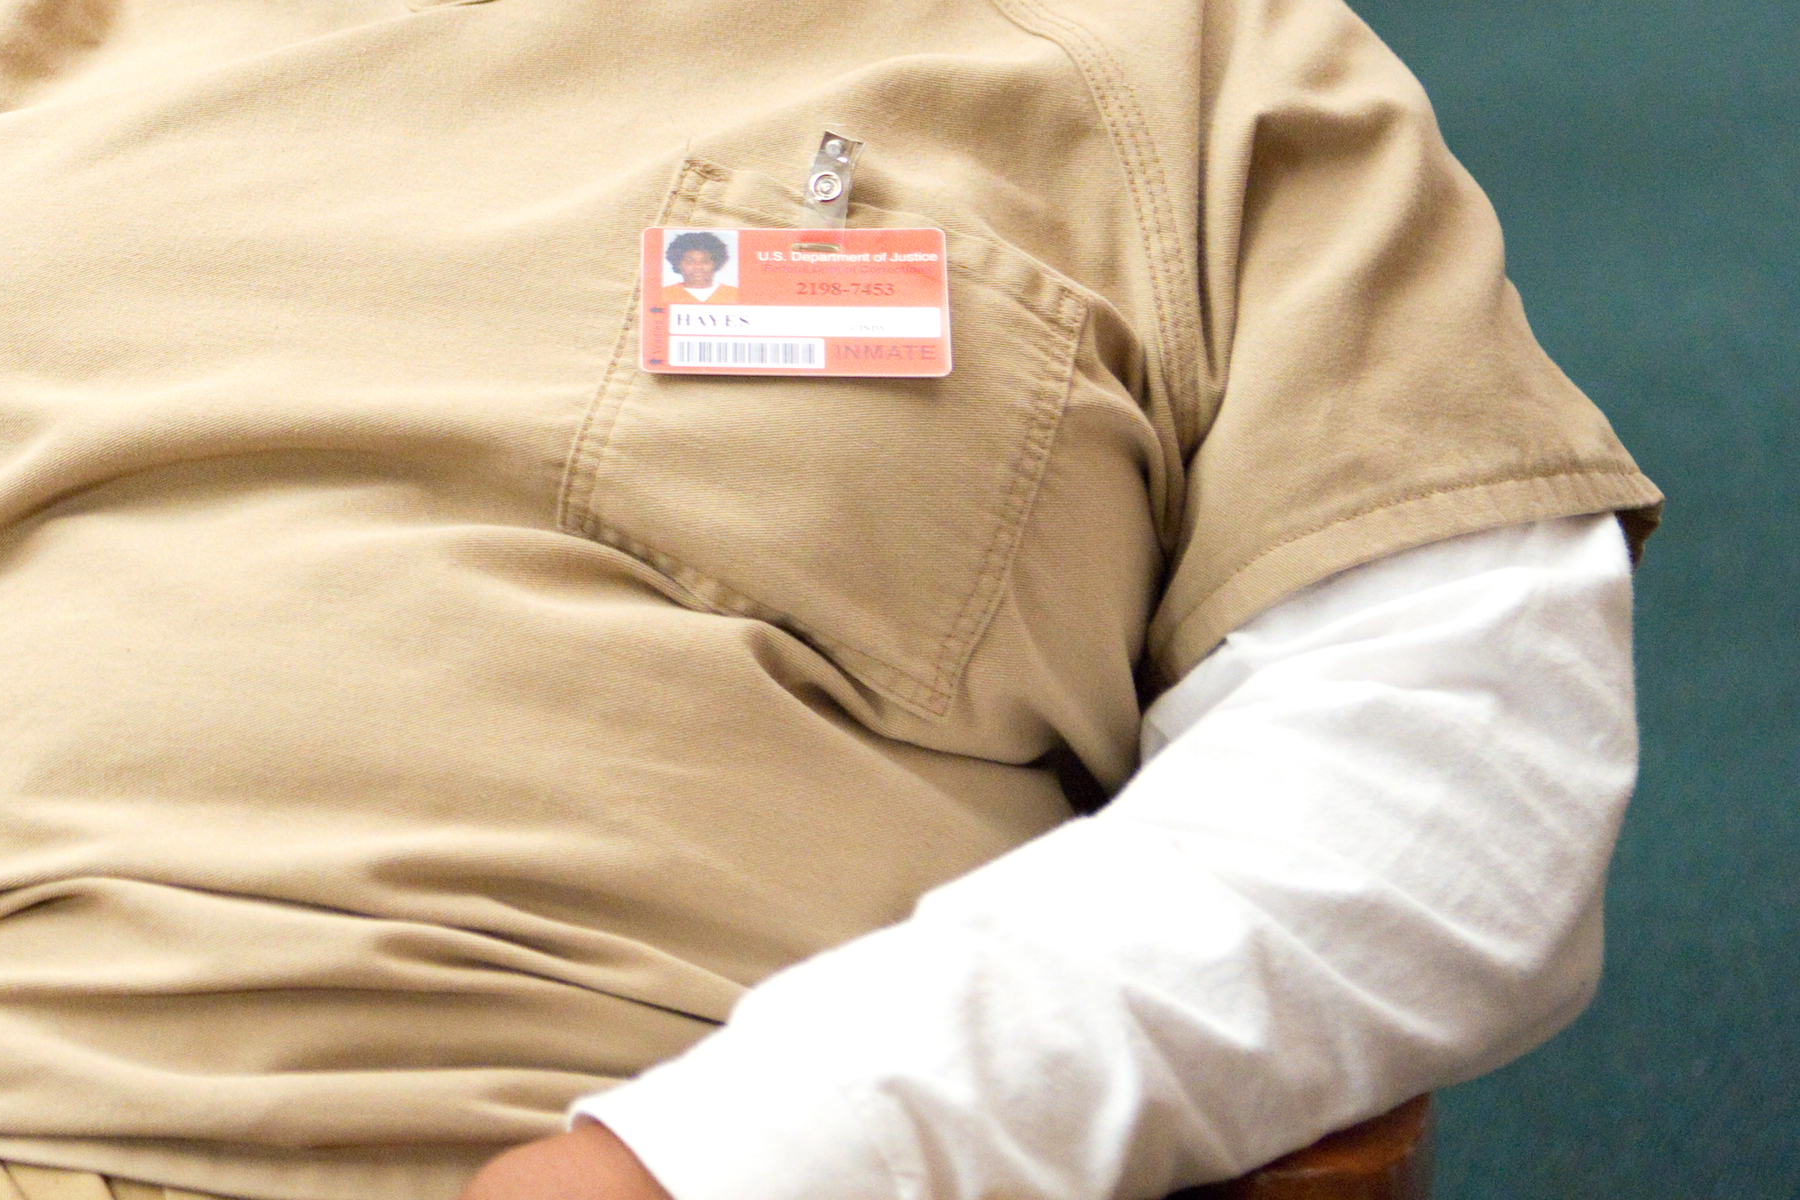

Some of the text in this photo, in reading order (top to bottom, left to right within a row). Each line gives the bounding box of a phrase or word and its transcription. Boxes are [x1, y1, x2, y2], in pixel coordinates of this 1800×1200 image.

[757, 251, 938, 264] U.S. Department of Justice
[796, 282, 895, 296] 2198-7453
[676, 313, 751, 328] HAYES
[835, 344, 936, 361] INMATE
